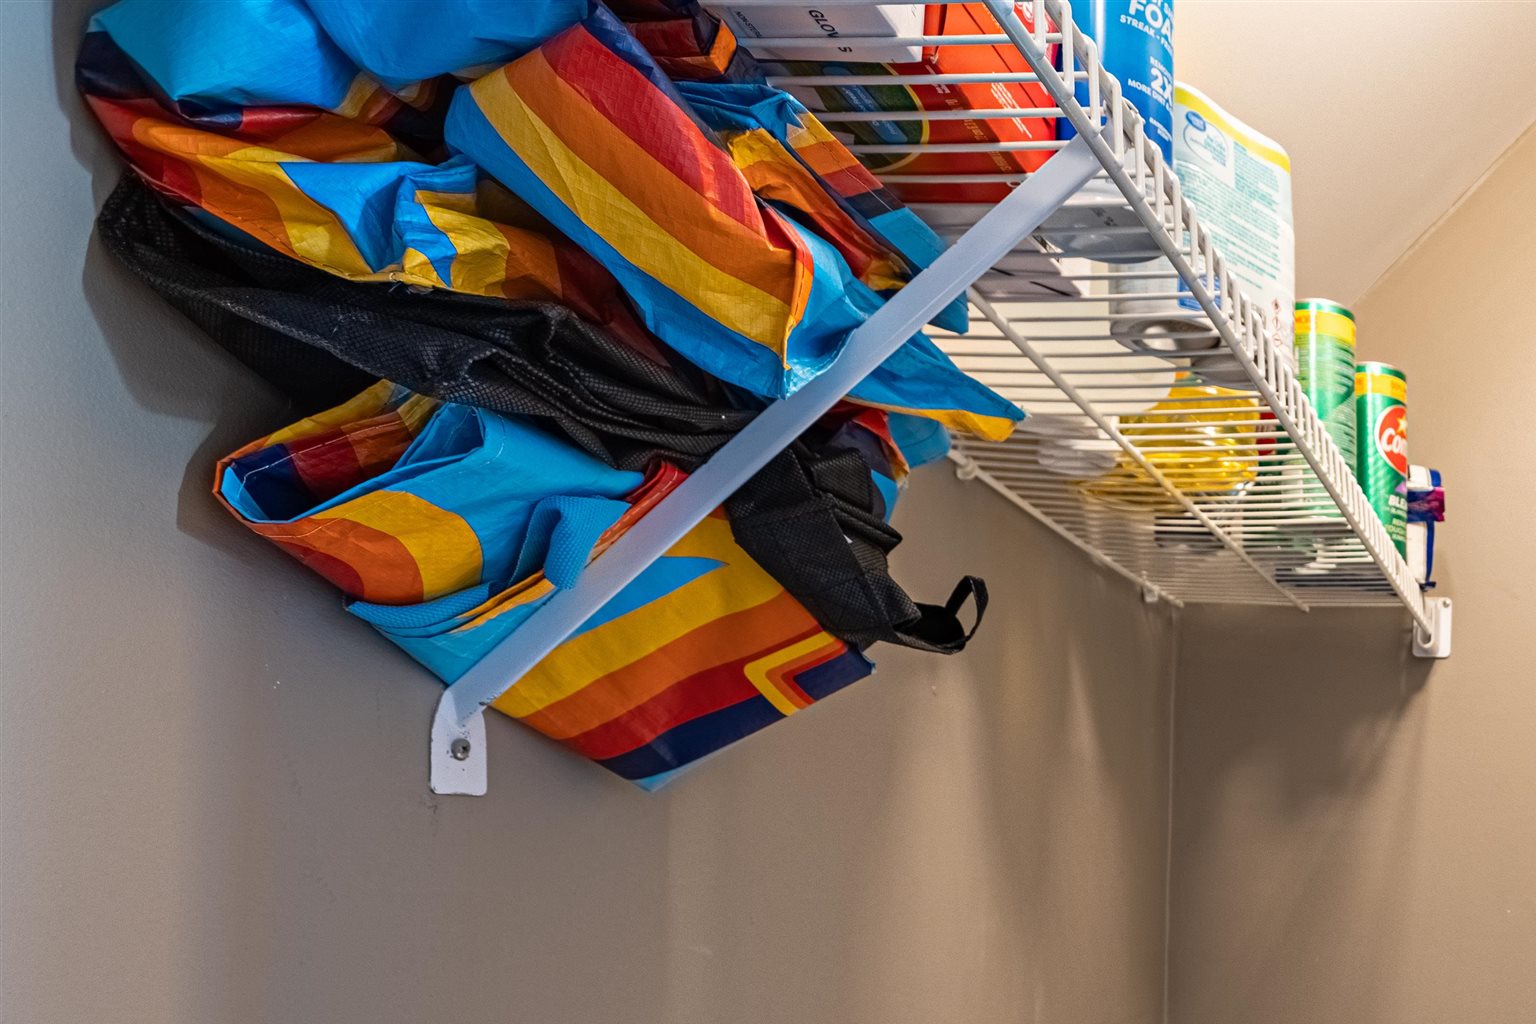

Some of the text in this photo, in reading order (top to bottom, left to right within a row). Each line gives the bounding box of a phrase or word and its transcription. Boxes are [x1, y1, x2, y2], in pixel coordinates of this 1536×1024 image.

[808, 9, 853, 53] GLOVS
[1120, 15, 1156, 38] STREAK
[1128, 0, 1173, 43] FOA
[1128, 79, 1152, 98] MORE
